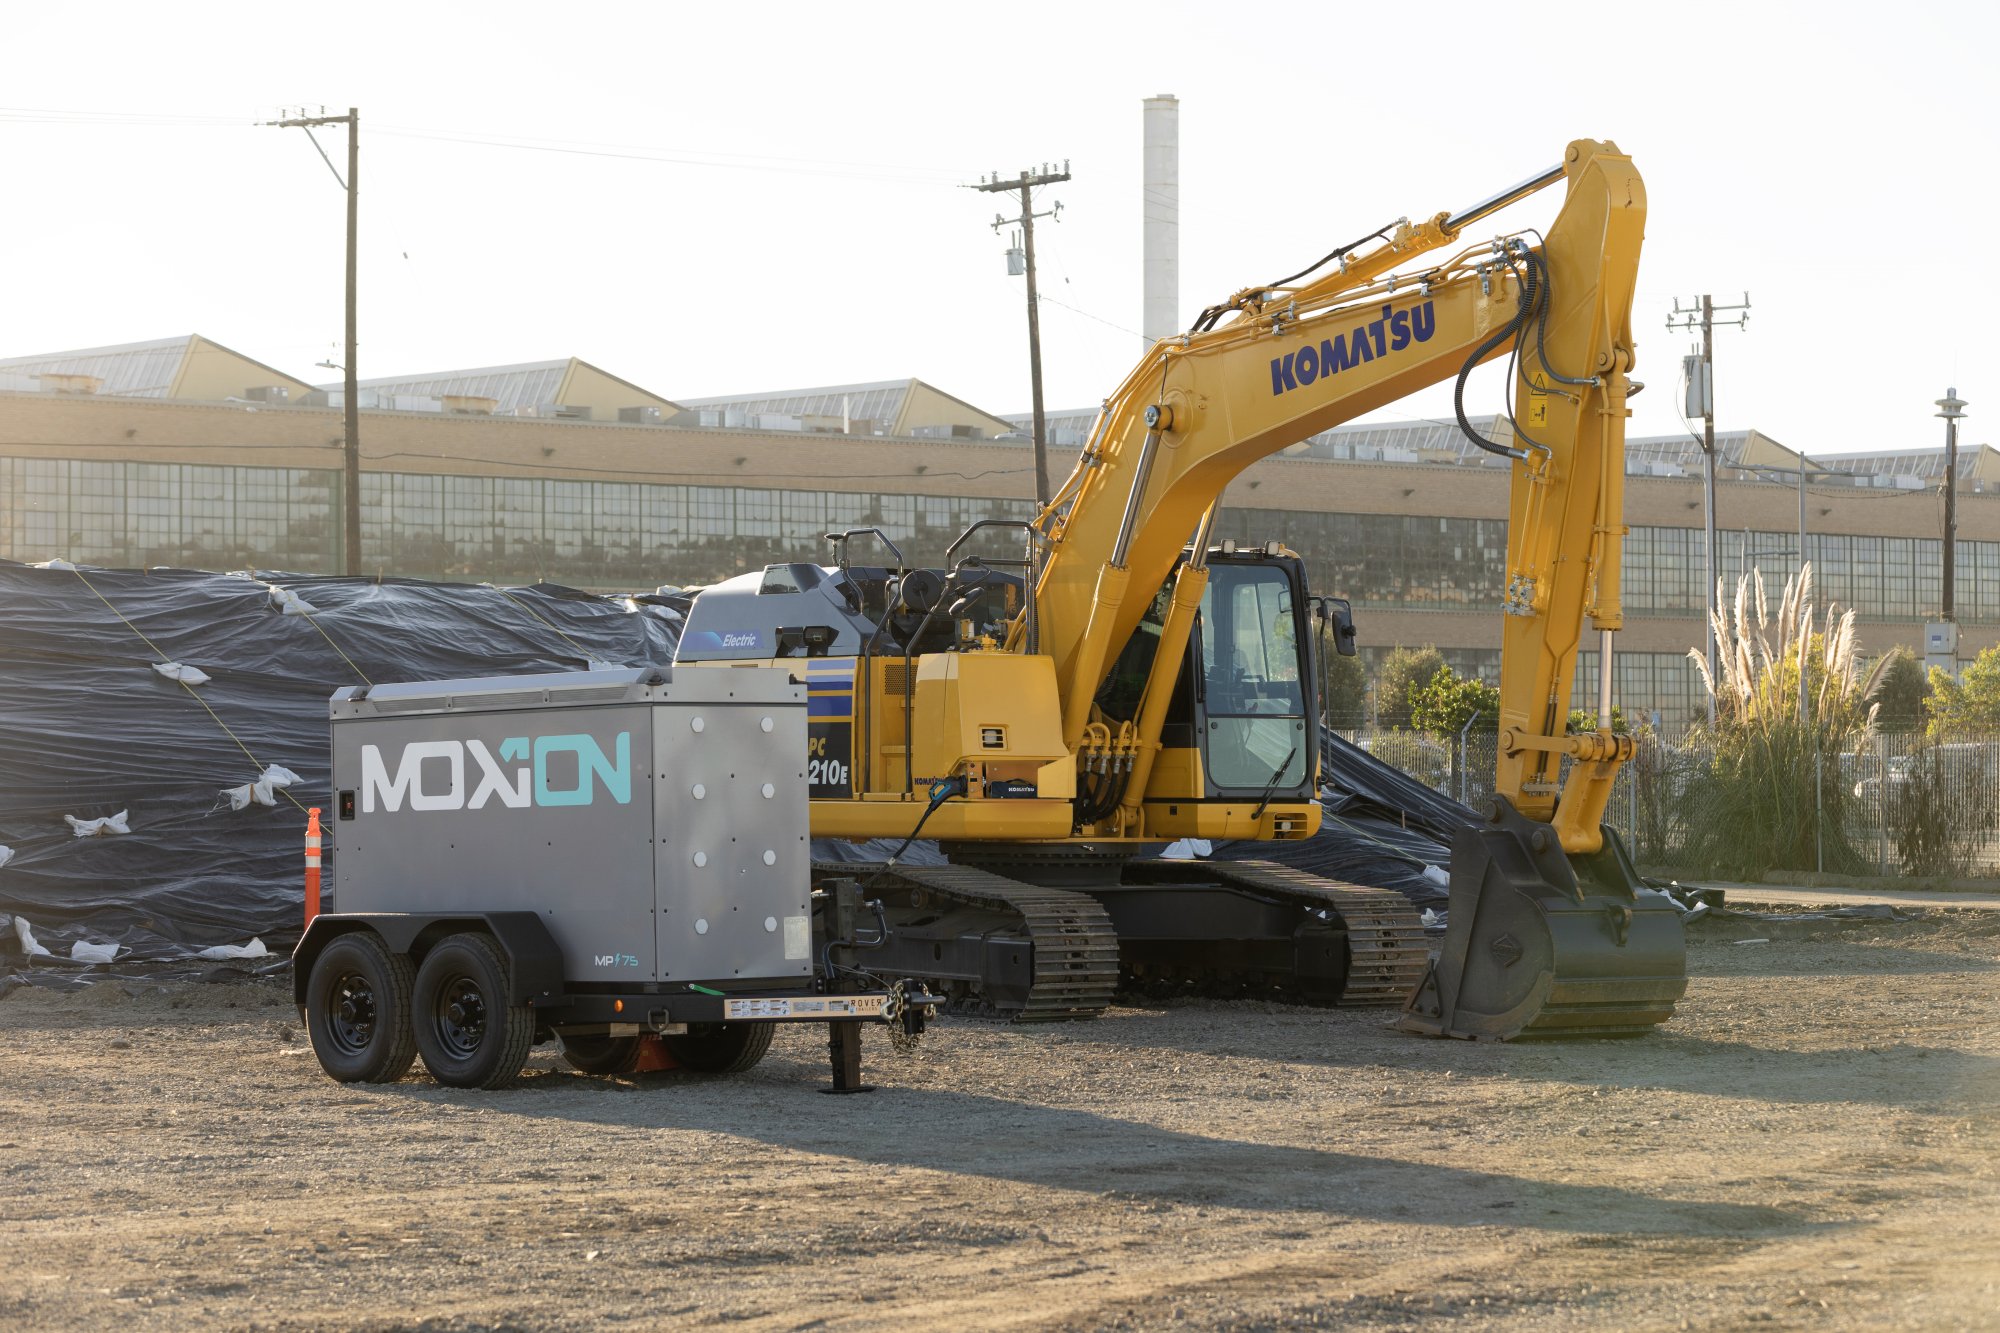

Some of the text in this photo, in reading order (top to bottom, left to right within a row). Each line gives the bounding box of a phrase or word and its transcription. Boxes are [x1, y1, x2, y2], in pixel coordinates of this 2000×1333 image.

[1271, 301, 1436, 396] KOMATSU
[723, 633, 756, 647] Electric
[808, 737, 826, 756] PC
[362, 732, 631, 812] MOXION
[808, 760, 848, 785] 210E
[914, 776, 945, 785] KOMAT
